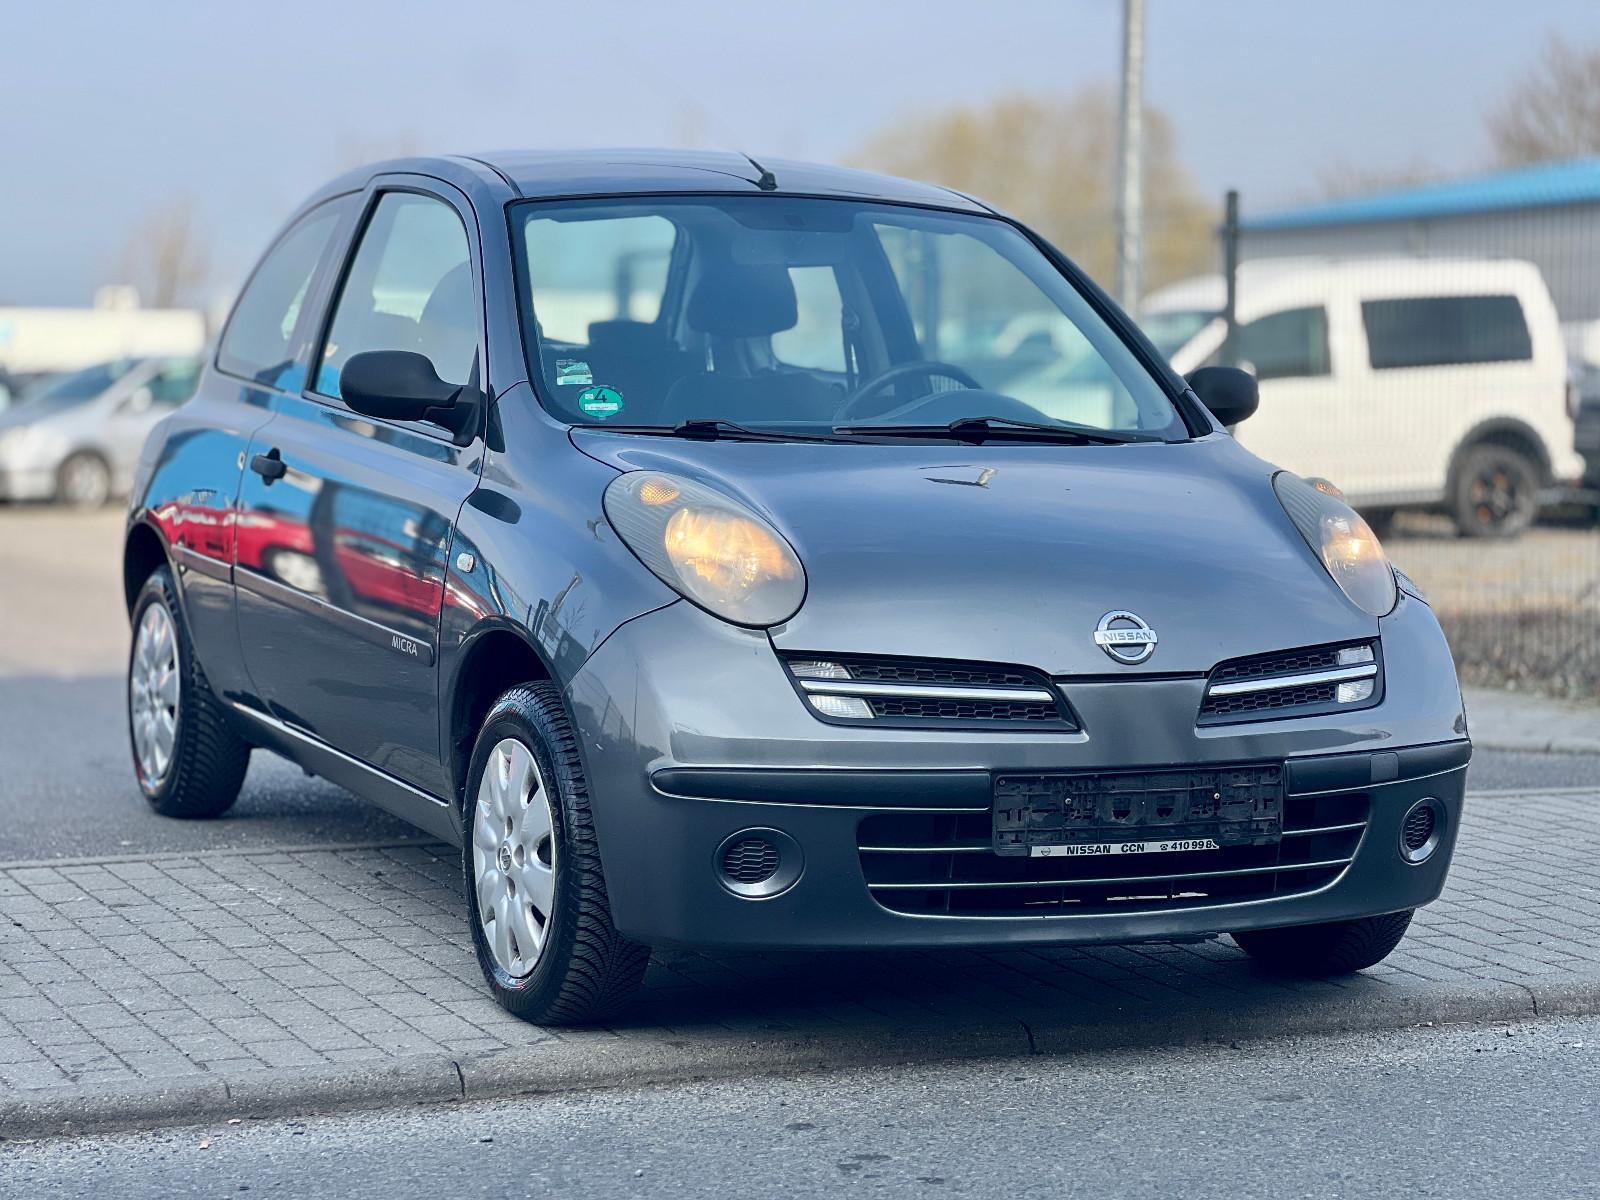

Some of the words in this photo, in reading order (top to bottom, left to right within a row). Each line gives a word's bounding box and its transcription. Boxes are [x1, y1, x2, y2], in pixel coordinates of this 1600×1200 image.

[594, 389, 607, 403] 4
[1103, 632, 1151, 641] NISSAN
[392, 635, 418, 656] MICRA
[1067, 845, 1111, 855] NISSAN
[1121, 843, 1145, 853] CCN
